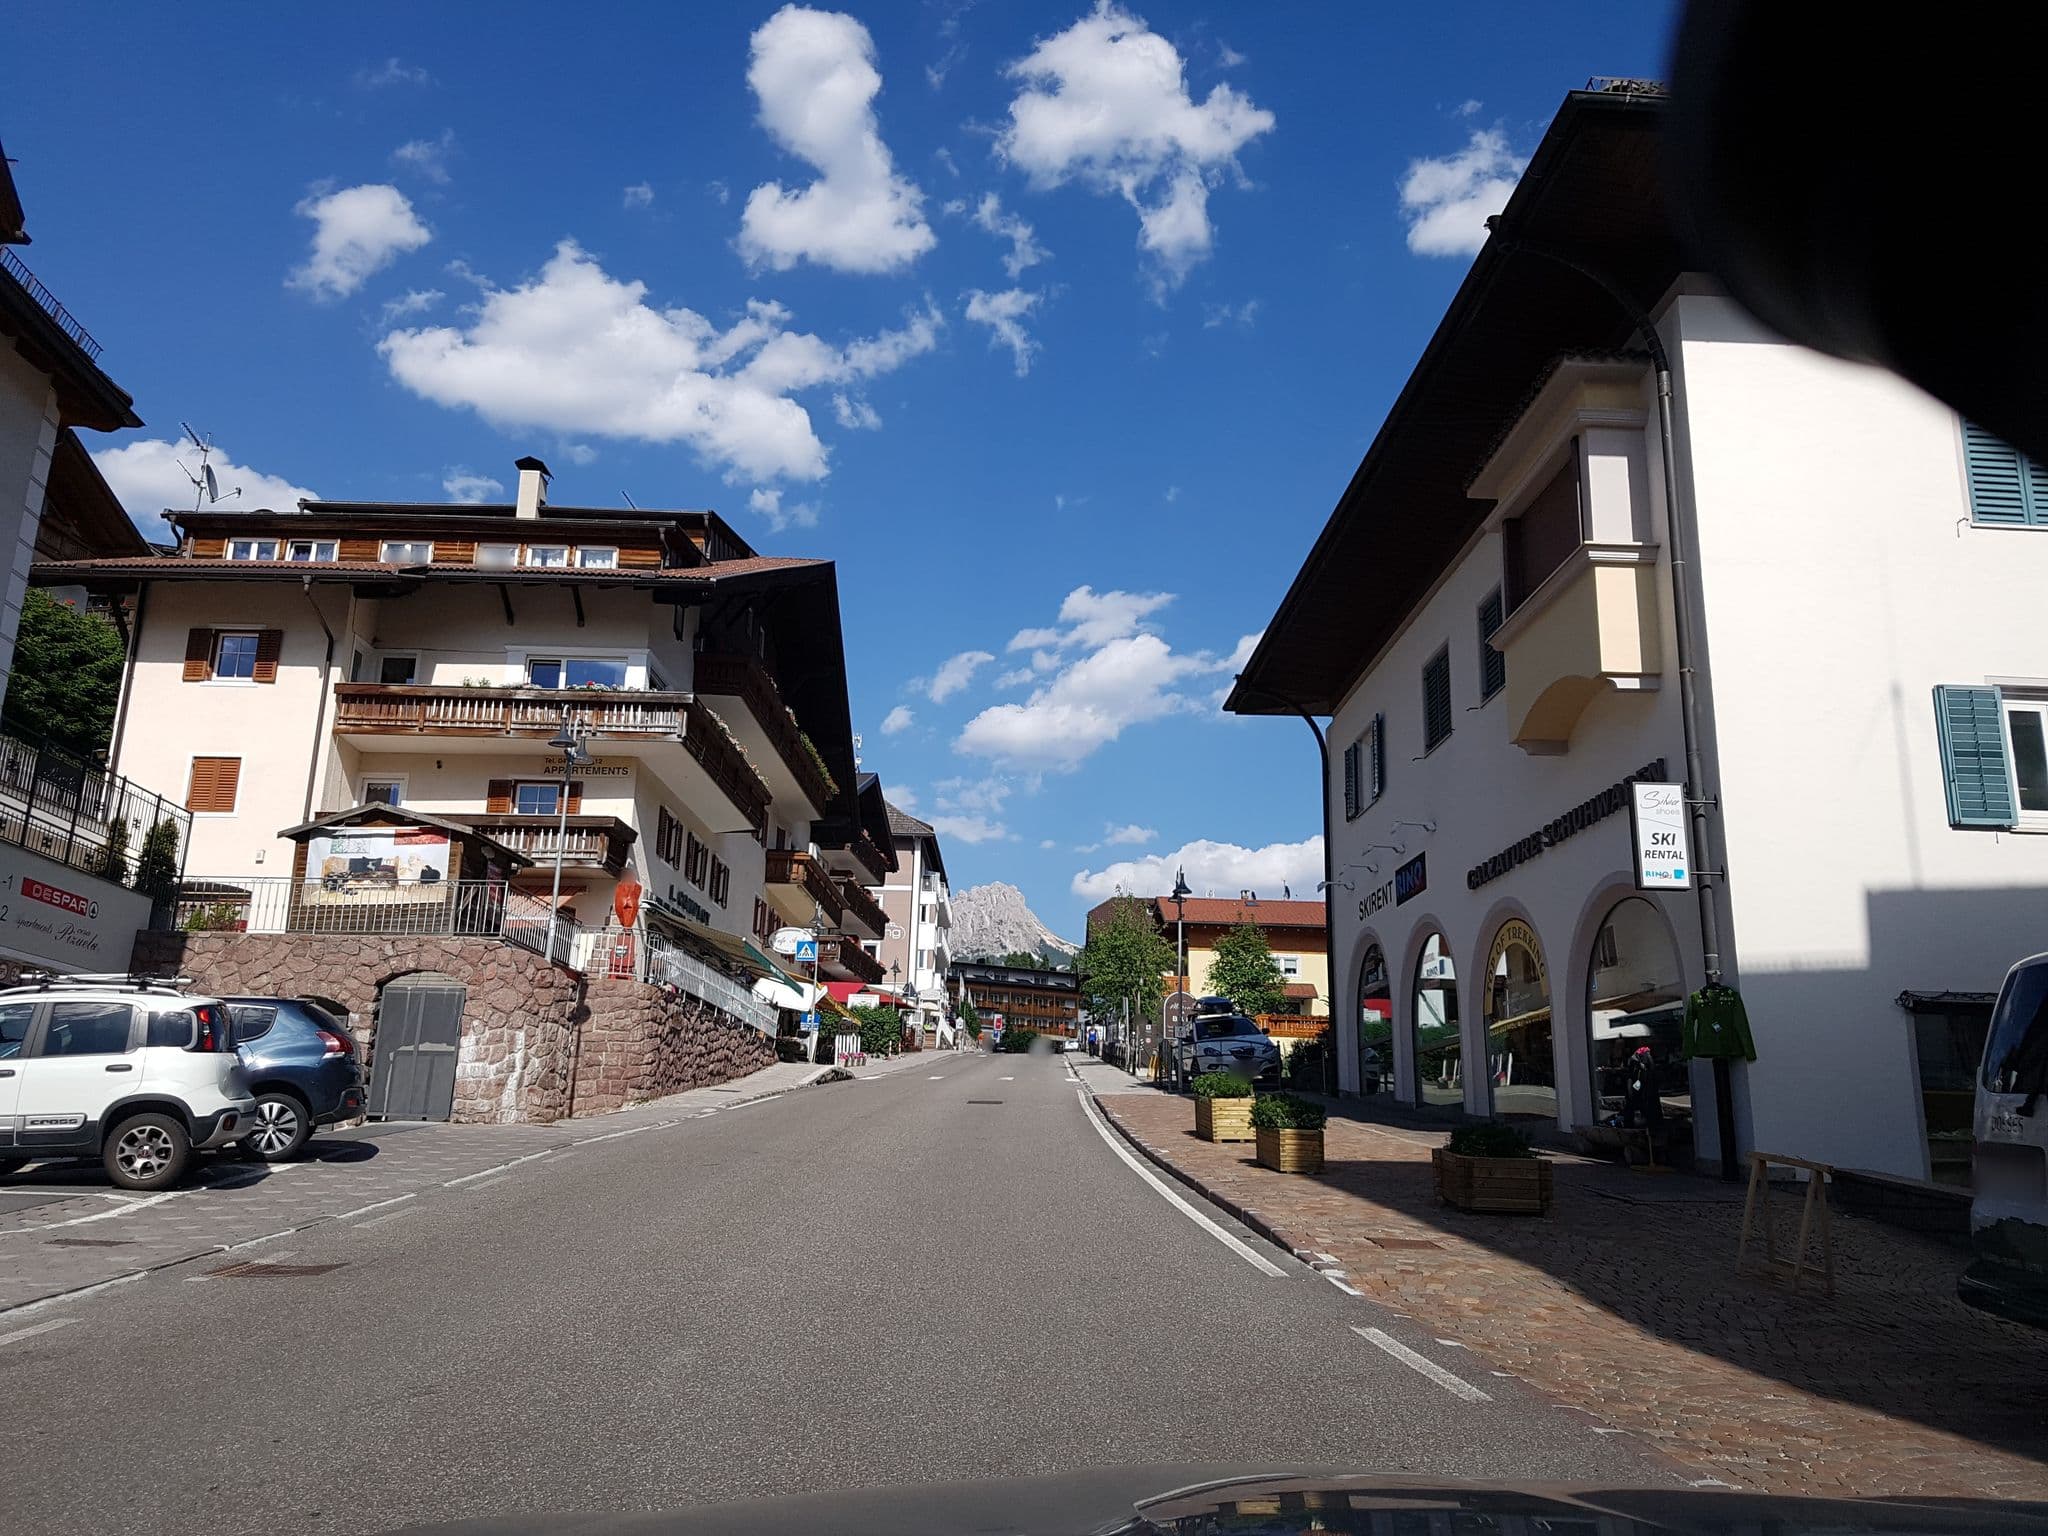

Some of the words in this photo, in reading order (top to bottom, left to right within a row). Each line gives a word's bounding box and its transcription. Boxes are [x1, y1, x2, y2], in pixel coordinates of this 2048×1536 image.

[1651, 832, 1676, 846] SKI
[1644, 849, 1684, 860] RENTAL
[32, 884, 88, 913] DESPAR
[1359, 880, 1394, 921] SKIRENT
[1506, 926, 1545, 978] TREKKING
[30, 1118, 78, 1126] CROSS
